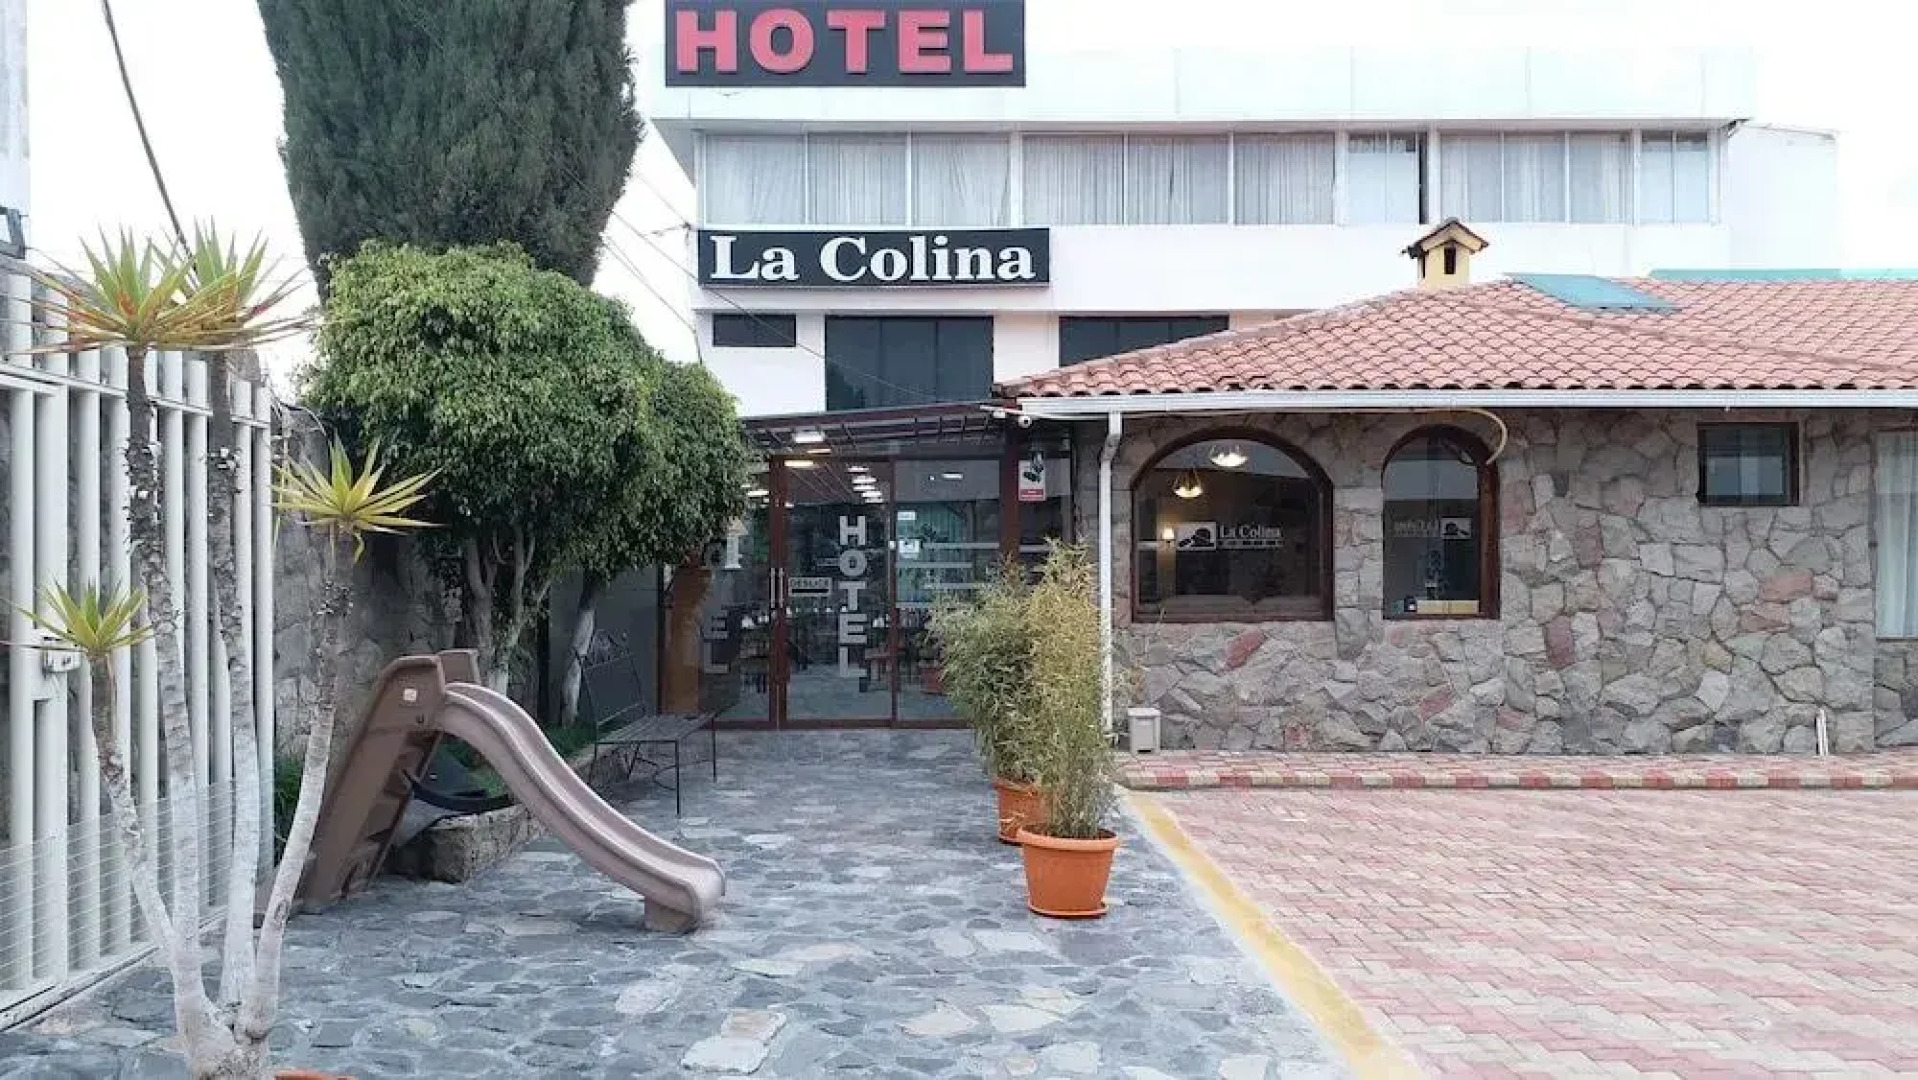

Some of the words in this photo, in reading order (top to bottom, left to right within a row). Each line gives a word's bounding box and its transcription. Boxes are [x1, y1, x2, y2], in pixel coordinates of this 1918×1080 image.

[675, 8, 1013, 73] HOTEL
[710, 236, 798, 281] La
[820, 235, 1036, 282] Colina
[839, 515, 868, 678] HOTEL
